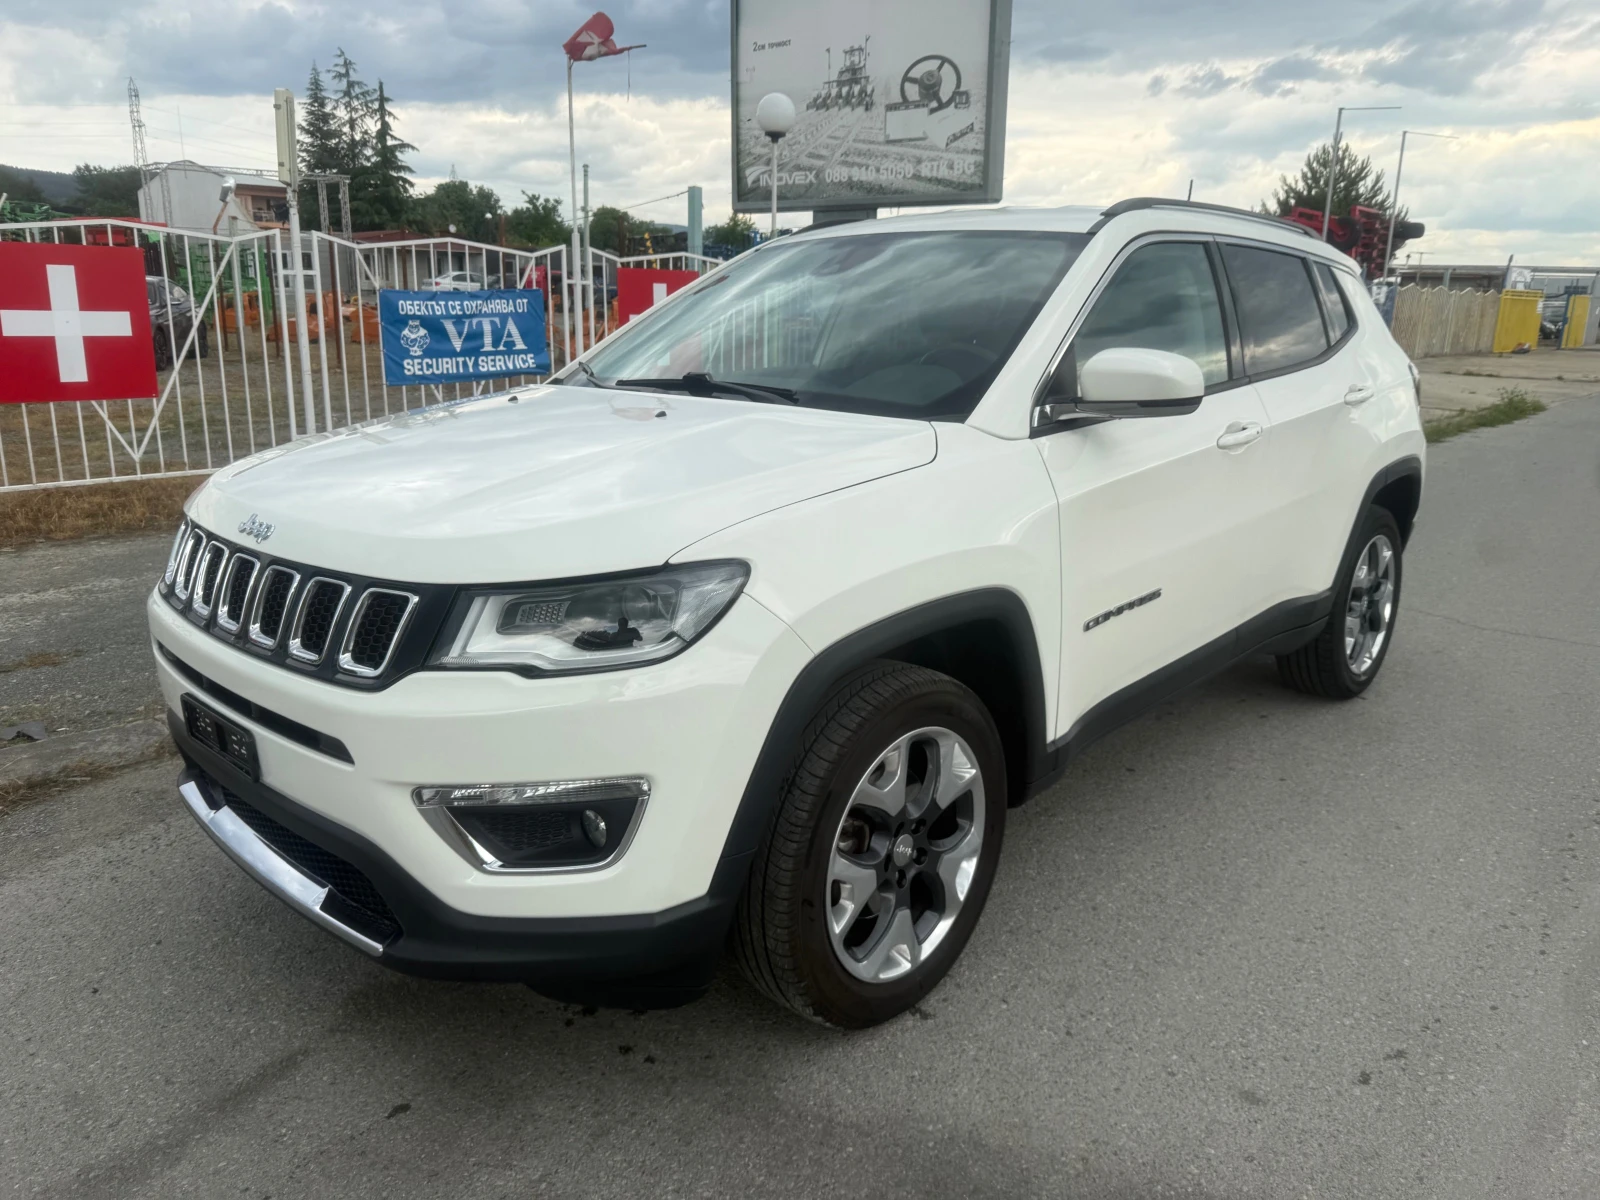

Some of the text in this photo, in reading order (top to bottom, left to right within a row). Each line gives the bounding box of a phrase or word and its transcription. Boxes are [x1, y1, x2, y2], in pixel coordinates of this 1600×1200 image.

[825, 167, 849, 184] 088
[398, 299, 528, 316] ОБЕКТЪТ СЕ ОХРАНЯВА ОТ
[440, 316, 528, 353] VTA
[403, 353, 537, 376] SECURITY SERVICE
[237, 513, 276, 544] Jeep
